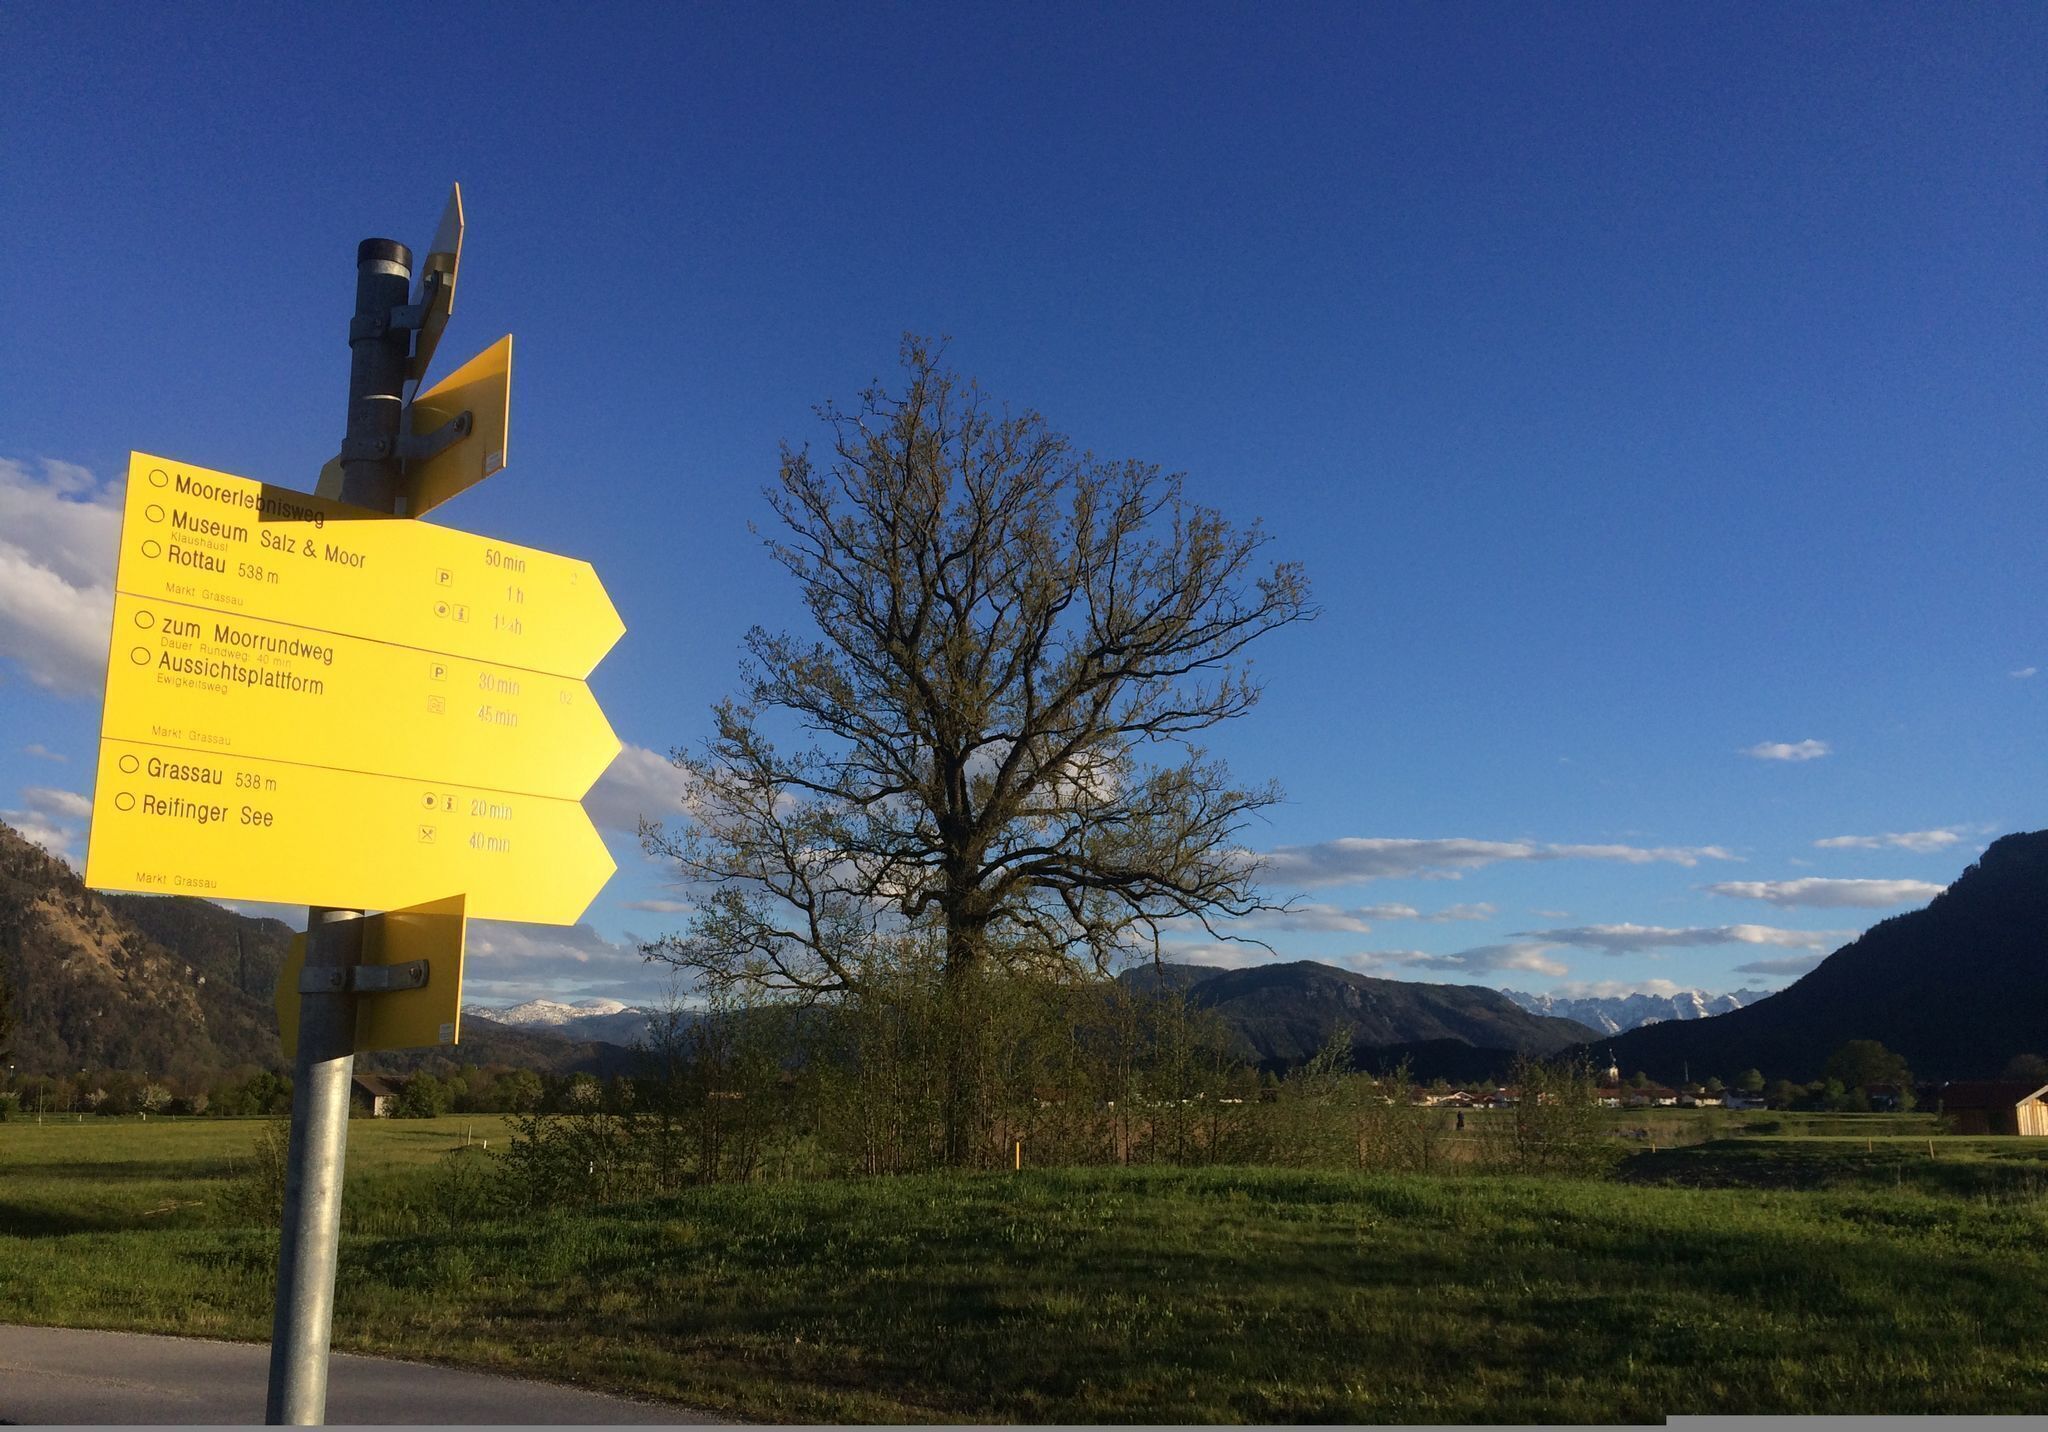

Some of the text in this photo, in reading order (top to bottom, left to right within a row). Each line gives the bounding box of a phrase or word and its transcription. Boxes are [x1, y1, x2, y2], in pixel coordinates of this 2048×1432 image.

[175, 473, 325, 529] Moorerlebnisweg
[172, 508, 366, 569] Museum Salz & Moor
[168, 544, 280, 585] Rottau 538 m
[485, 549, 526, 574] 50 min
[165, 582, 244, 607] Markt Grassau
[160, 636, 193, 651] Dauer
[273, 657, 292, 668] min
[161, 617, 334, 666] zum Moorrundweg
[156, 672, 228, 696] Ewigkeitsweg
[158, 650, 324, 696] Aussichtsplattform
[478, 671, 520, 696] 30 min
[478, 704, 518, 727] 45 min
[151, 725, 231, 746] Markt Grassau
[147, 757, 277, 791] Grassau 538 m
[143, 794, 273, 828] Reifinger See
[471, 798, 512, 821] 20 min
[469, 831, 510, 854] 40 min
[135, 871, 218, 889] Markt Grassau
